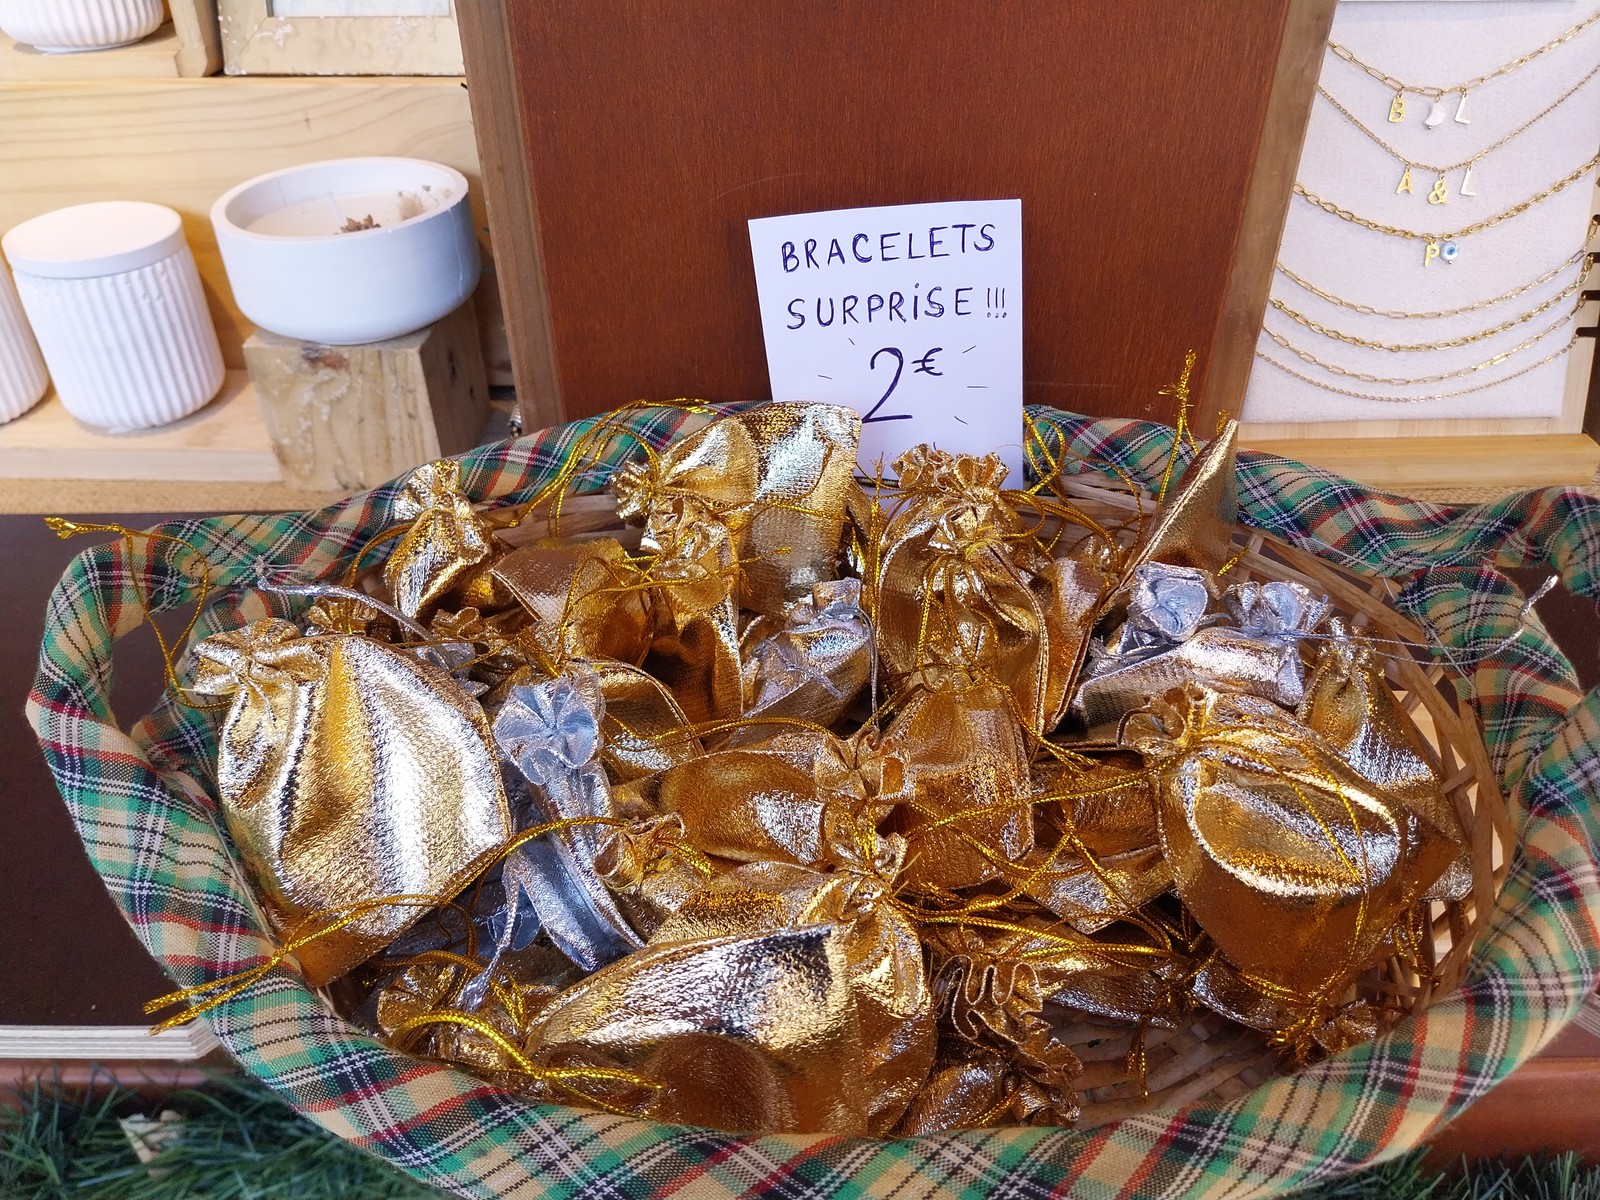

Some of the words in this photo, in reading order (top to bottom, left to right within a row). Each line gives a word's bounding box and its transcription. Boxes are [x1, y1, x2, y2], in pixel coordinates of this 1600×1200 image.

[1388, 96, 1405, 123] B
[1454, 93, 1471, 125] L
[1396, 169, 1413, 194] A
[1428, 179, 1449, 205] &
[1459, 168, 1477, 196] L
[781, 223, 996, 273] BRACELETS
[1424, 243, 1440, 267] P
